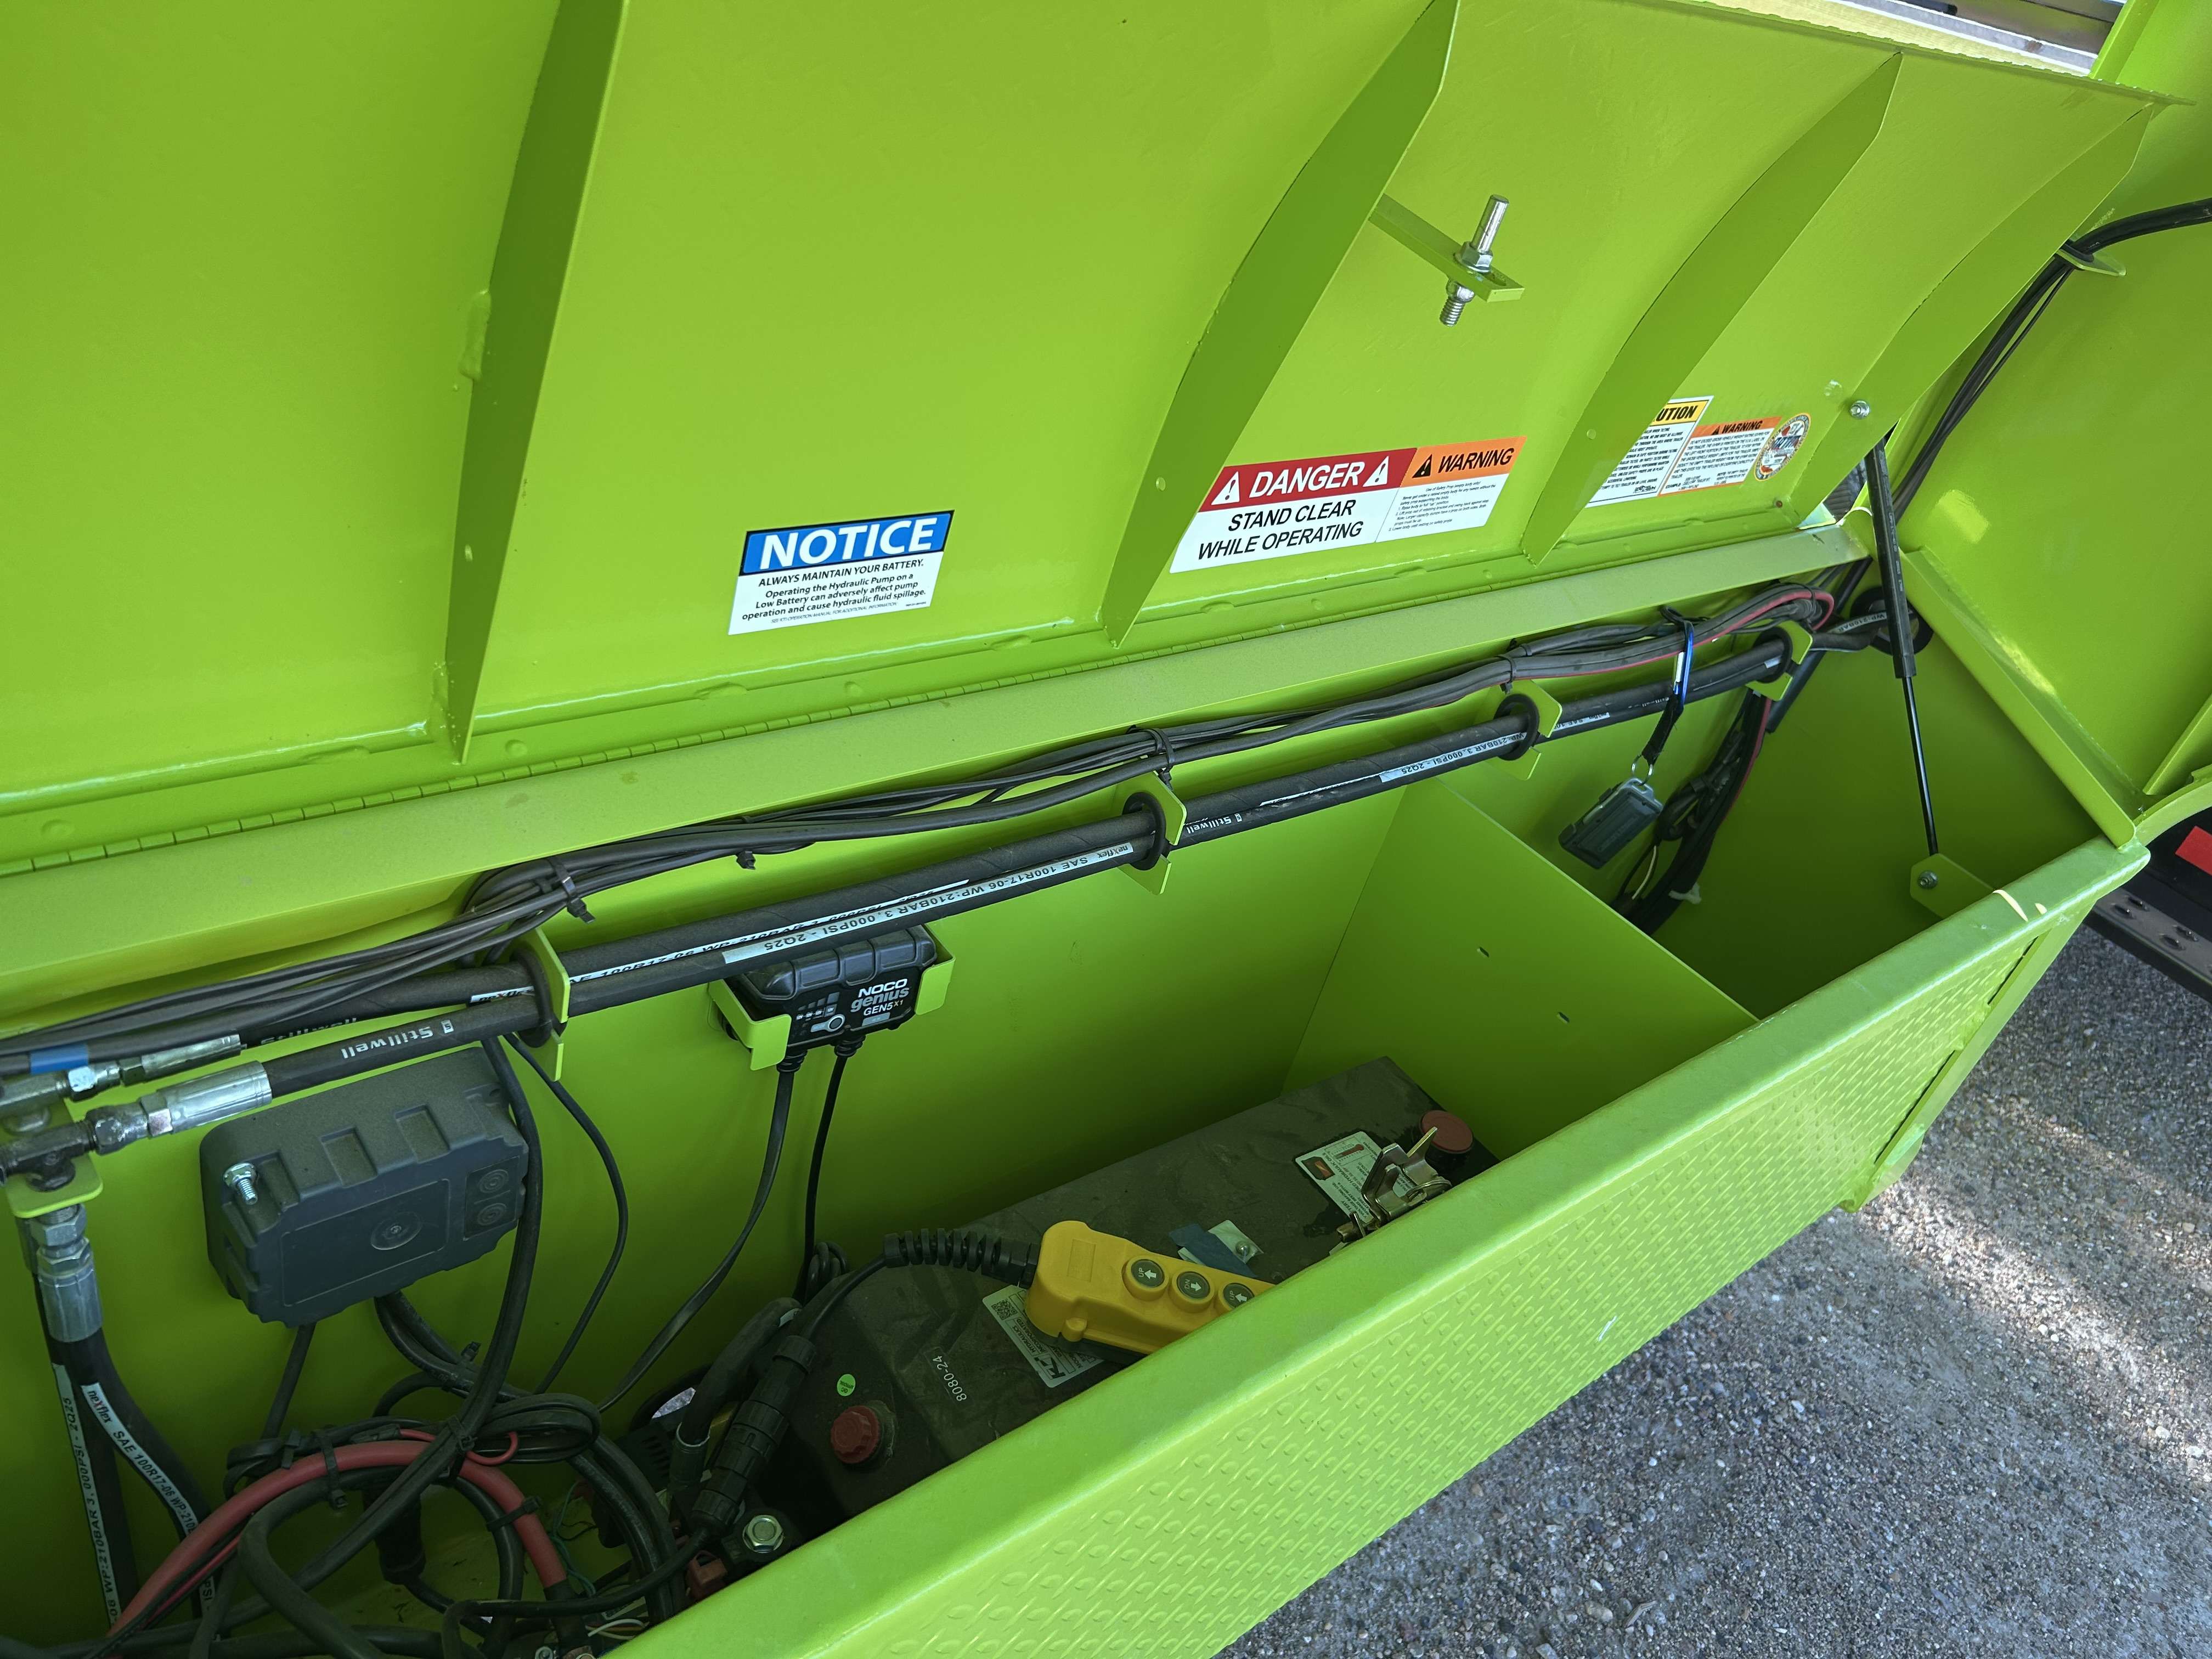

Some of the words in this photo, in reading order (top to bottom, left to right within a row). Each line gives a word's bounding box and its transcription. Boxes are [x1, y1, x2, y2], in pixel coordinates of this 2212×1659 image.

[1656, 405, 1698, 422] UTION
[1722, 420, 1763, 434] WARNING
[1437, 447, 1514, 473] WARNING
[1249, 462, 1365, 498] DANGER
[1228, 506, 1290, 531] STAND
[1295, 500, 1356, 525] CLEAR
[760, 517, 937, 569] NOTICE
[1198, 535, 1260, 560] WHILE
[1262, 520, 1363, 551] OPERATING
[759, 574, 799, 586] ALWAYS
[802, 568, 851, 581] MAINTAIN
[855, 565, 880, 574] YOUR
[882, 559, 924, 571] BATTERY.
[766, 586, 810, 598] Operating
[830, 578, 869, 591] Hydraulic
[871, 575, 894, 585] Pump
[776, 594, 808, 606] Battery
[828, 586, 868, 599] adversely
[870, 583, 893, 592] affect
[894, 582, 918, 592] pump
[742, 606, 786, 620] operation
[788, 603, 805, 613] and
[807, 602, 831, 611] cause
[833, 595, 871, 607] hydraulic
[873, 591, 891, 601] fluid
[894, 588, 926, 600] spillage.
[1186, 816, 1232, 834] Stillwell
[1062, 856, 1088, 870] SAE
[988, 866, 1057, 890] 100R17-06
[899, 885, 985, 915] WP:210BAR
[764, 934, 807, 951] 2Q25
[859, 978, 908, 997] NOCO
[850, 988, 910, 1012] genius
[341, 1026, 433, 1059] Stillwell
[1138, 1267, 1144, 1277] UP
[1184, 1279, 1190, 1289] DN
[1229, 1290, 1235, 1300] UP
[1012, 1325, 1036, 1353] HYDRAULICS
[933, 1355, 967, 1401] 8080-24
[113, 1431, 136, 1453] SAE
[134, 1454, 174, 1500] 100R17-06
